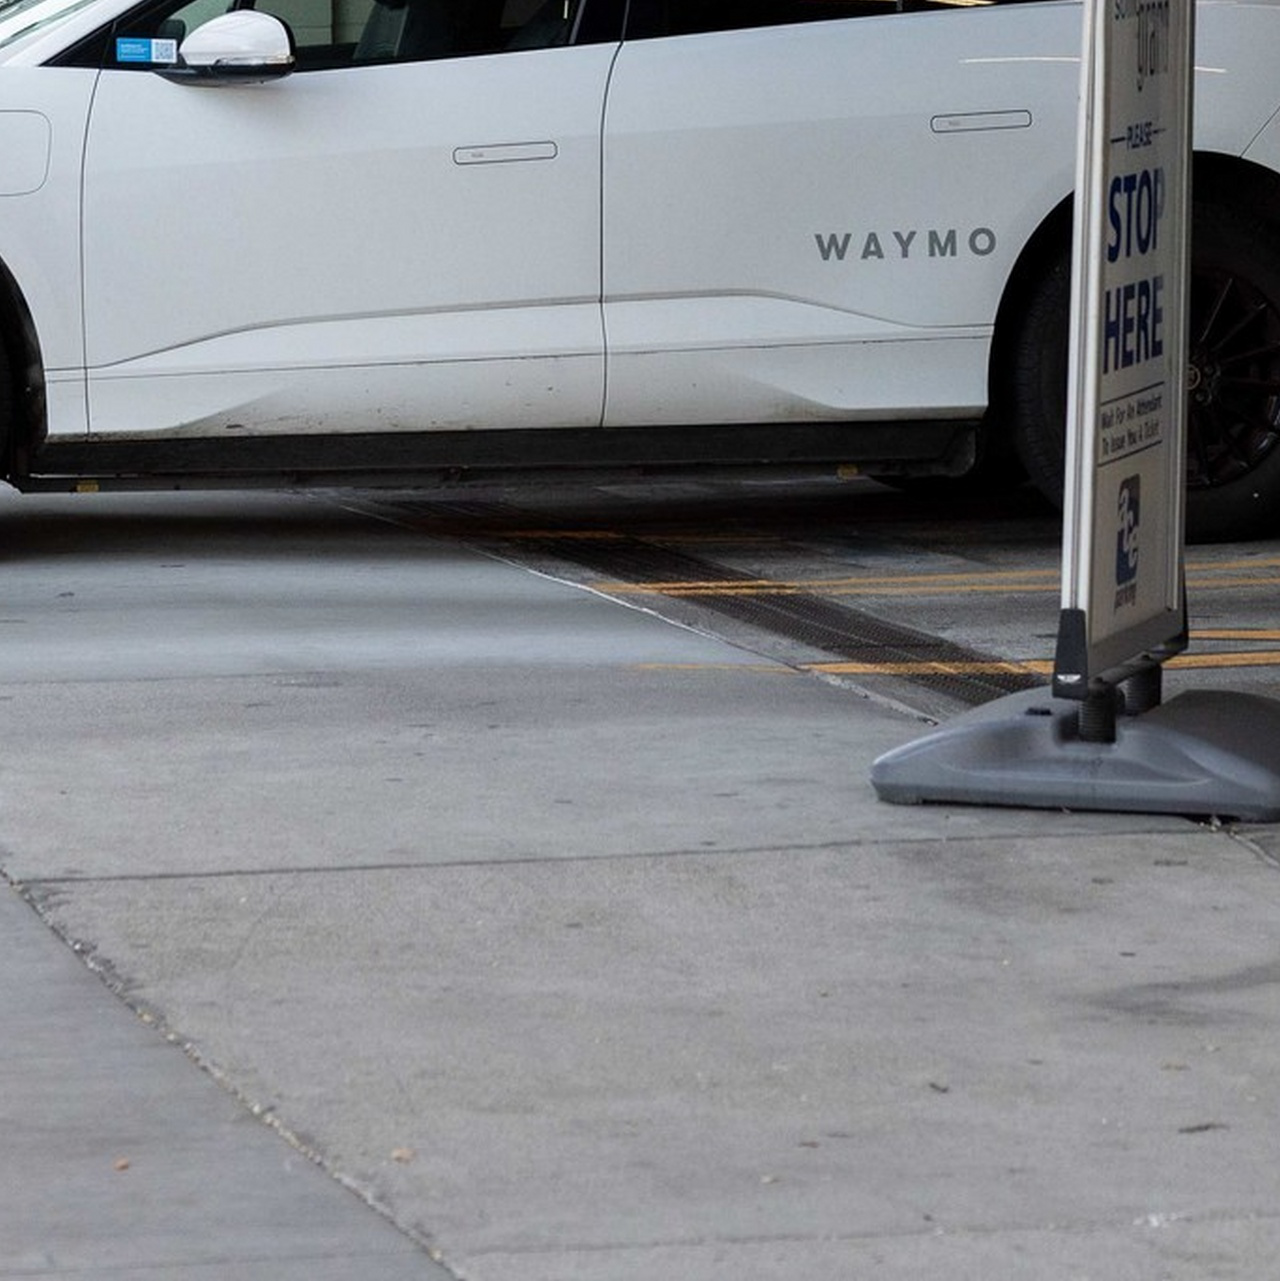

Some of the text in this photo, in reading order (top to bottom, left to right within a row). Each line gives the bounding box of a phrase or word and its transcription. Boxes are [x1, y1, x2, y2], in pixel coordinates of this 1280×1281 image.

[814, 227, 997, 261] WAYMO
[1107, 167, 1166, 264] STOP
[1102, 274, 1163, 375] HERE
